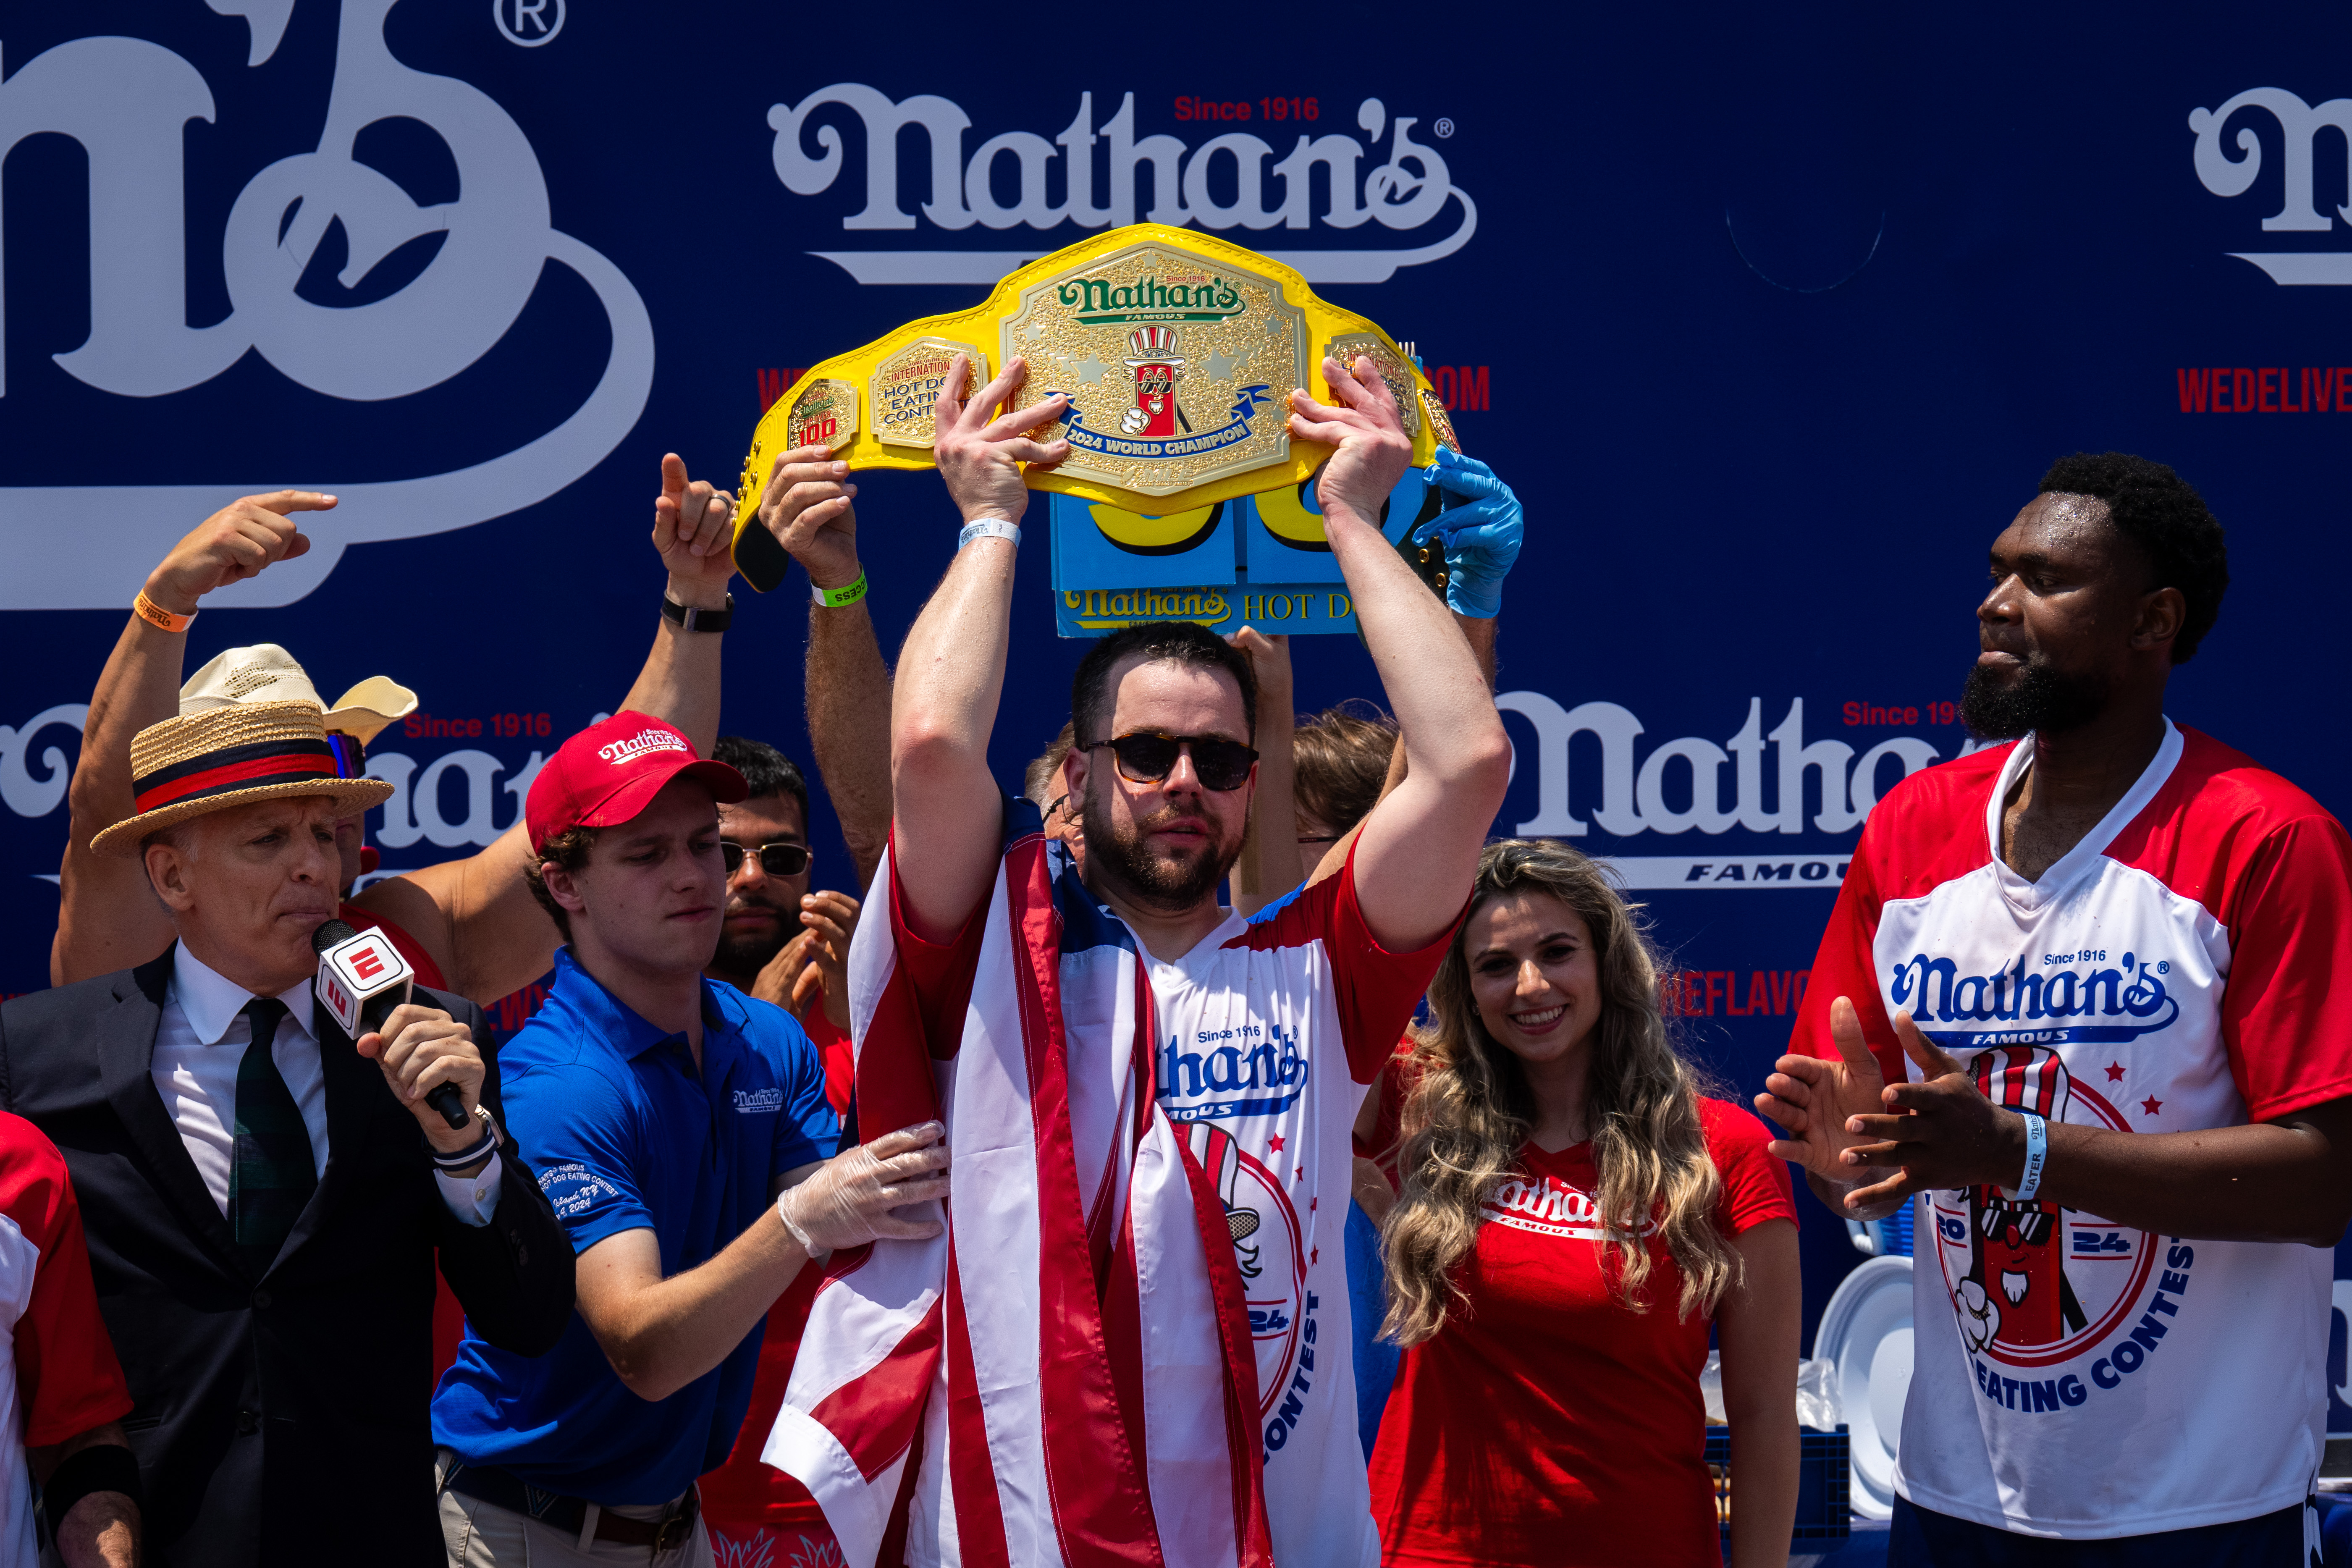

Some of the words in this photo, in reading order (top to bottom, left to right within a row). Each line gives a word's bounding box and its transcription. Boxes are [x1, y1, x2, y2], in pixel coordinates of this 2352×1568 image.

[1174, 97, 1251, 122] Since
[1260, 97, 1319, 121] 1916
[767, 82, 1476, 252] Nathan's
[1057, 275, 1246, 315] Nathan's
[891, 361, 950, 383] INTERNATION
[884, 381, 921, 399] HOT
[892, 391, 941, 410] EATIN
[800, 417, 836, 448] 100
[1067, 429, 1103, 449] 2024
[1106, 439, 1162, 456] WORLD
[1165, 423, 1248, 454] CHAMPION
[834, 579, 866, 602] CCESS
[1243, 594, 1316, 620] HOT
[1843, 701, 1919, 725] Since
[404, 714, 482, 738] Since
[490, 713, 552, 737] 1916
[598, 730, 687, 760] Nathan's
[635, 746, 674, 757] FAMOUS
[2044, 951, 2074, 965] Since
[2077, 949, 2106, 962] 1916
[1891, 952, 2179, 1029] Nathan's
[1198, 1030, 1233, 1043] Since
[1235, 1025, 1261, 1038] 1916
[1972, 1030, 2069, 1045] FAMOUS
[553, 1173, 566, 1184] DOG
[567, 1172, 590, 1182] EATING
[591, 1175, 619, 1197] CONTEST
[2024, 1153, 2041, 1192] EATER
[1560, 1181, 1586, 1194] Since
[569, 1197, 591, 1214] 2024
[1500, 1217, 1577, 1235] FAMOUS
[2073, 1231, 2131, 1253] 24
[1248, 1309, 1289, 1332] 24
[1264, 1290, 1319, 1466] ONTEST
[1976, 1358, 2088, 1413] EATING
